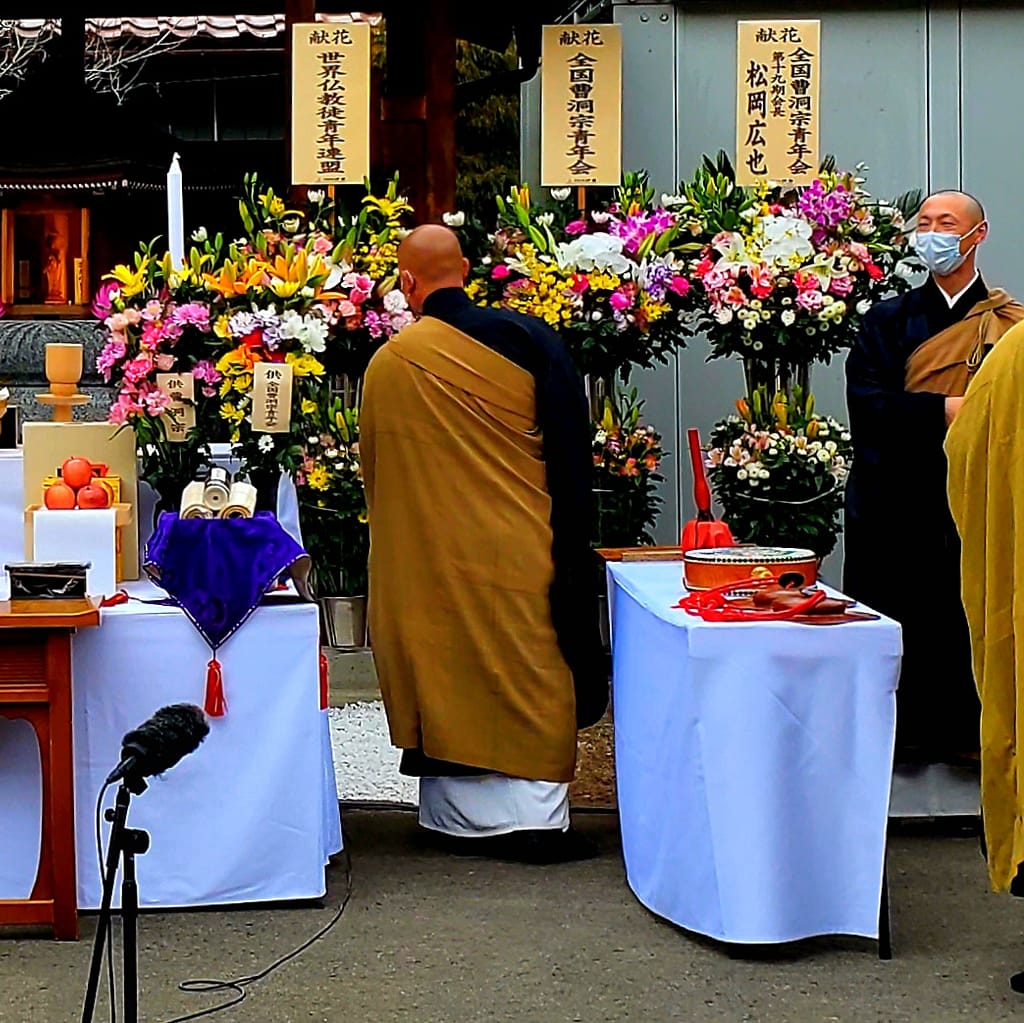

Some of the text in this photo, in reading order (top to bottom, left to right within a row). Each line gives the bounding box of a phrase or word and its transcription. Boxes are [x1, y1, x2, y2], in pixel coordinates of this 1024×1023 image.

[309, 29, 353, 45] 献花
[559, 29, 605, 46] 献花
[755, 26, 802, 44] 献花
[316, 51, 348, 175] 世界仏教徒青年連盟
[566, 52, 598, 176] 全国曹洞宗青年会
[745, 59, 769, 176] 松岡広也
[787, 46, 815, 176] 全国曹洞宗青年会
